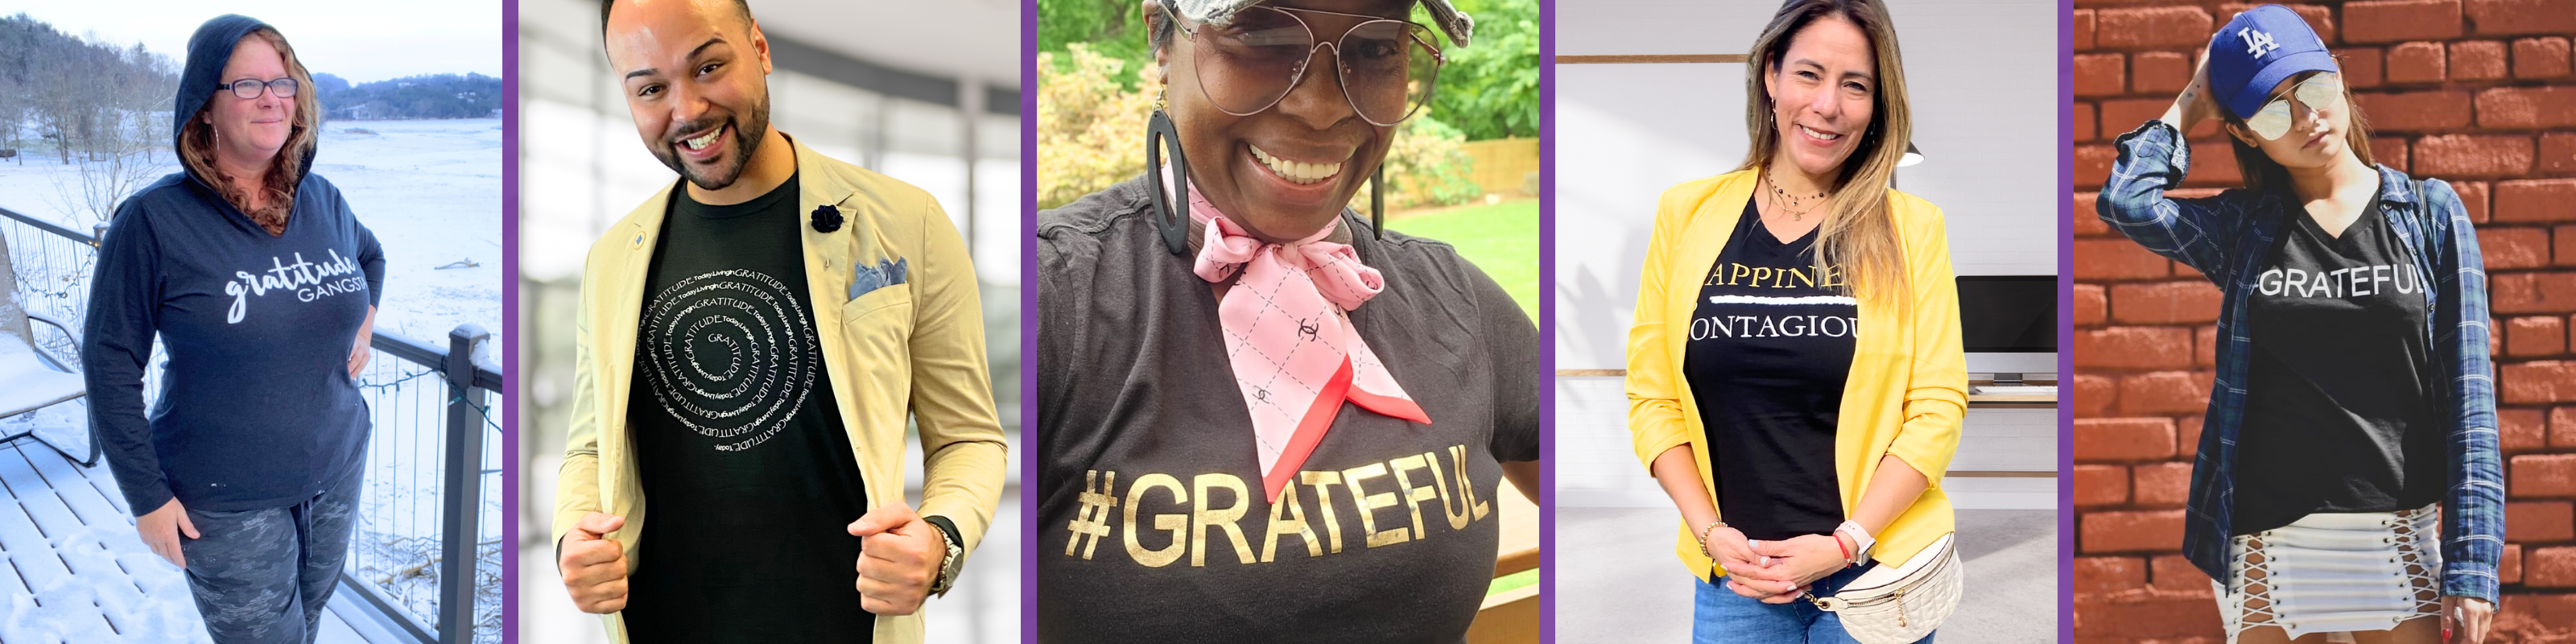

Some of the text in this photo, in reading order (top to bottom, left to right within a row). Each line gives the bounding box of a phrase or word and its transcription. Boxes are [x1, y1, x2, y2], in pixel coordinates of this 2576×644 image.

[2238, 27, 2280, 60] LA
[225, 248, 356, 324] gratitude
[645, 277, 694, 316] GRATITUDE
[720, 282, 774, 305] GRATITUDE
[735, 269, 789, 295] GRATITUDE
[1704, 262, 1845, 288] APPINE
[648, 297, 680, 351] GRATITUDE
[695, 298, 757, 314] GRATITUDE
[684, 315, 722, 359] GRATITUDE
[708, 333, 741, 378] GRATITUDE
[803, 328, 817, 388] GRATITUDE
[664, 337, 696, 390] GRATITUDE
[731, 343, 760, 397] GRATITUDE
[753, 347, 778, 403] GRATITUDE
[780, 339, 798, 398] GRATITUDE
[668, 386, 719, 419] GRATITUDE
[699, 423, 755, 437] GRATITUDE
[733, 419, 786, 451] GRATITUDE
[1065, 444, 1490, 568] #GRATEFUL
